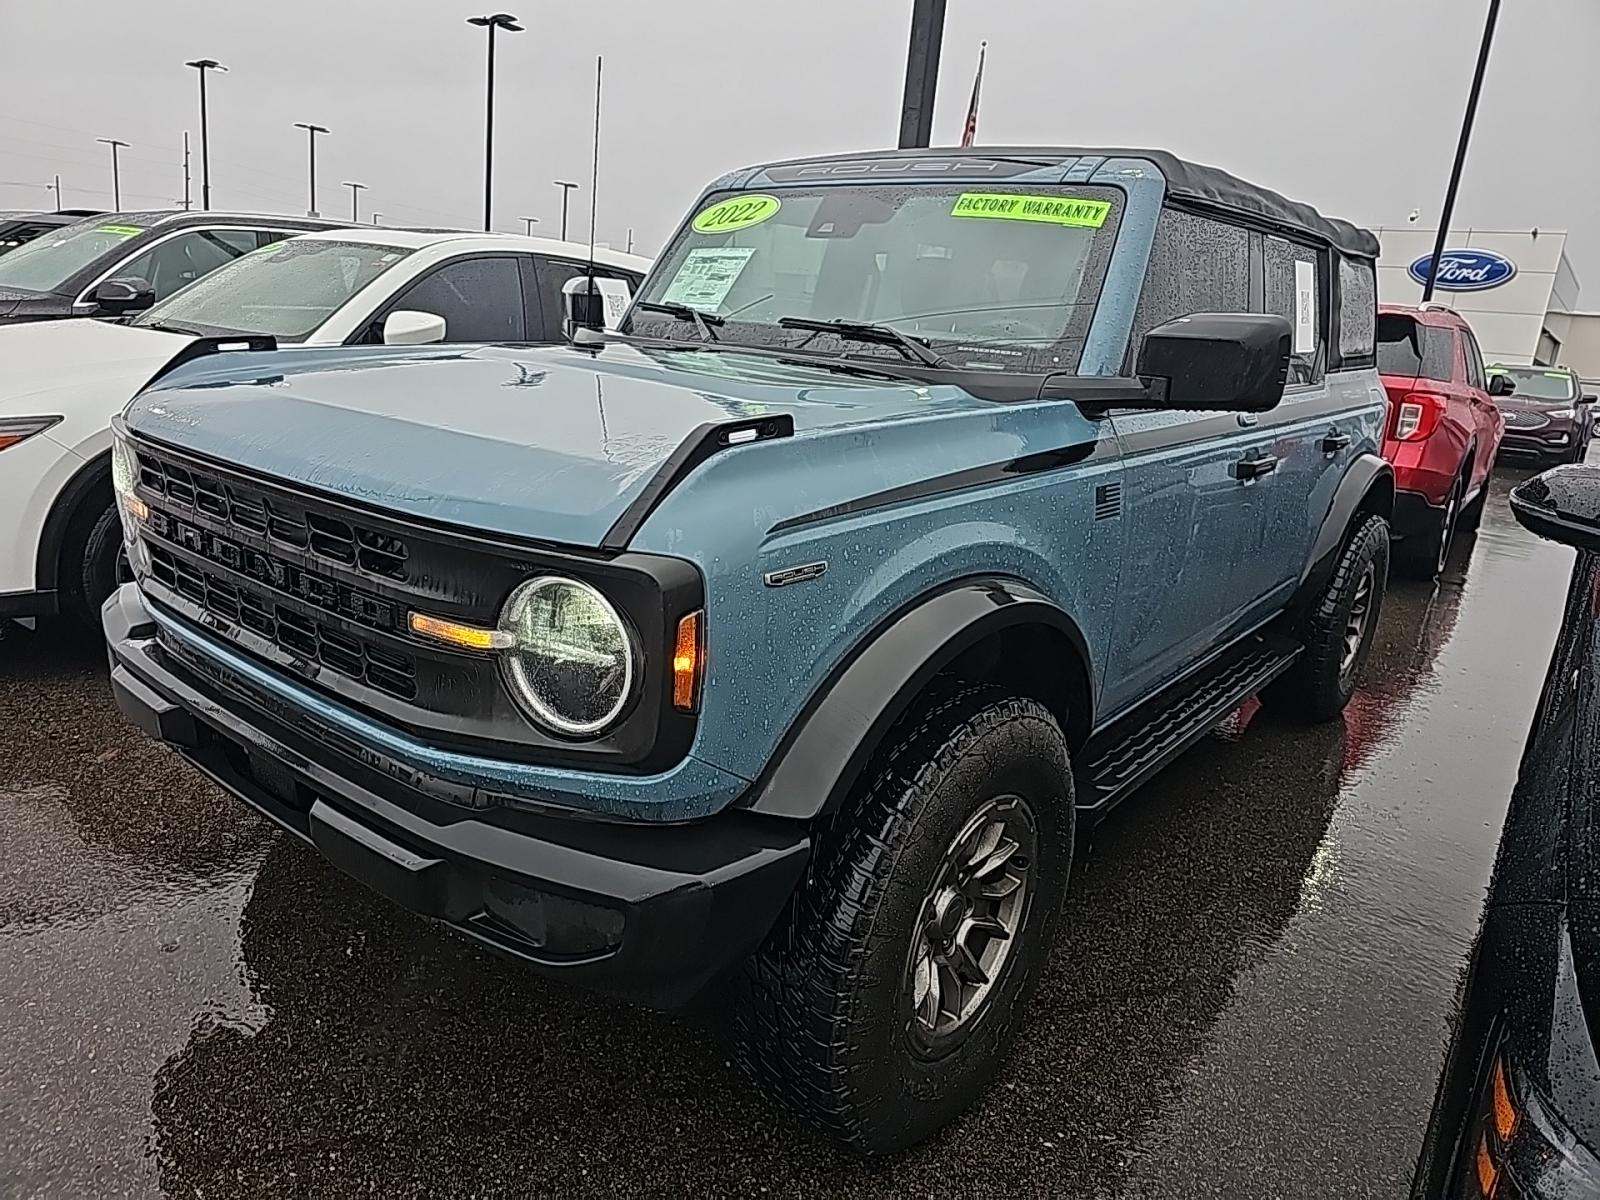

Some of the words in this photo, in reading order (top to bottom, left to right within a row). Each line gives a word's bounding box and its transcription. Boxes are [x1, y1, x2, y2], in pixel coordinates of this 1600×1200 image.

[797, 162, 998, 177] ROUSH
[702, 200, 768, 228] 2022
[957, 197, 1019, 214] FACTORY
[1022, 200, 1106, 221] WARRANTY
[1436, 257, 1489, 281] Ford
[149, 510, 398, 630] BRONCO
